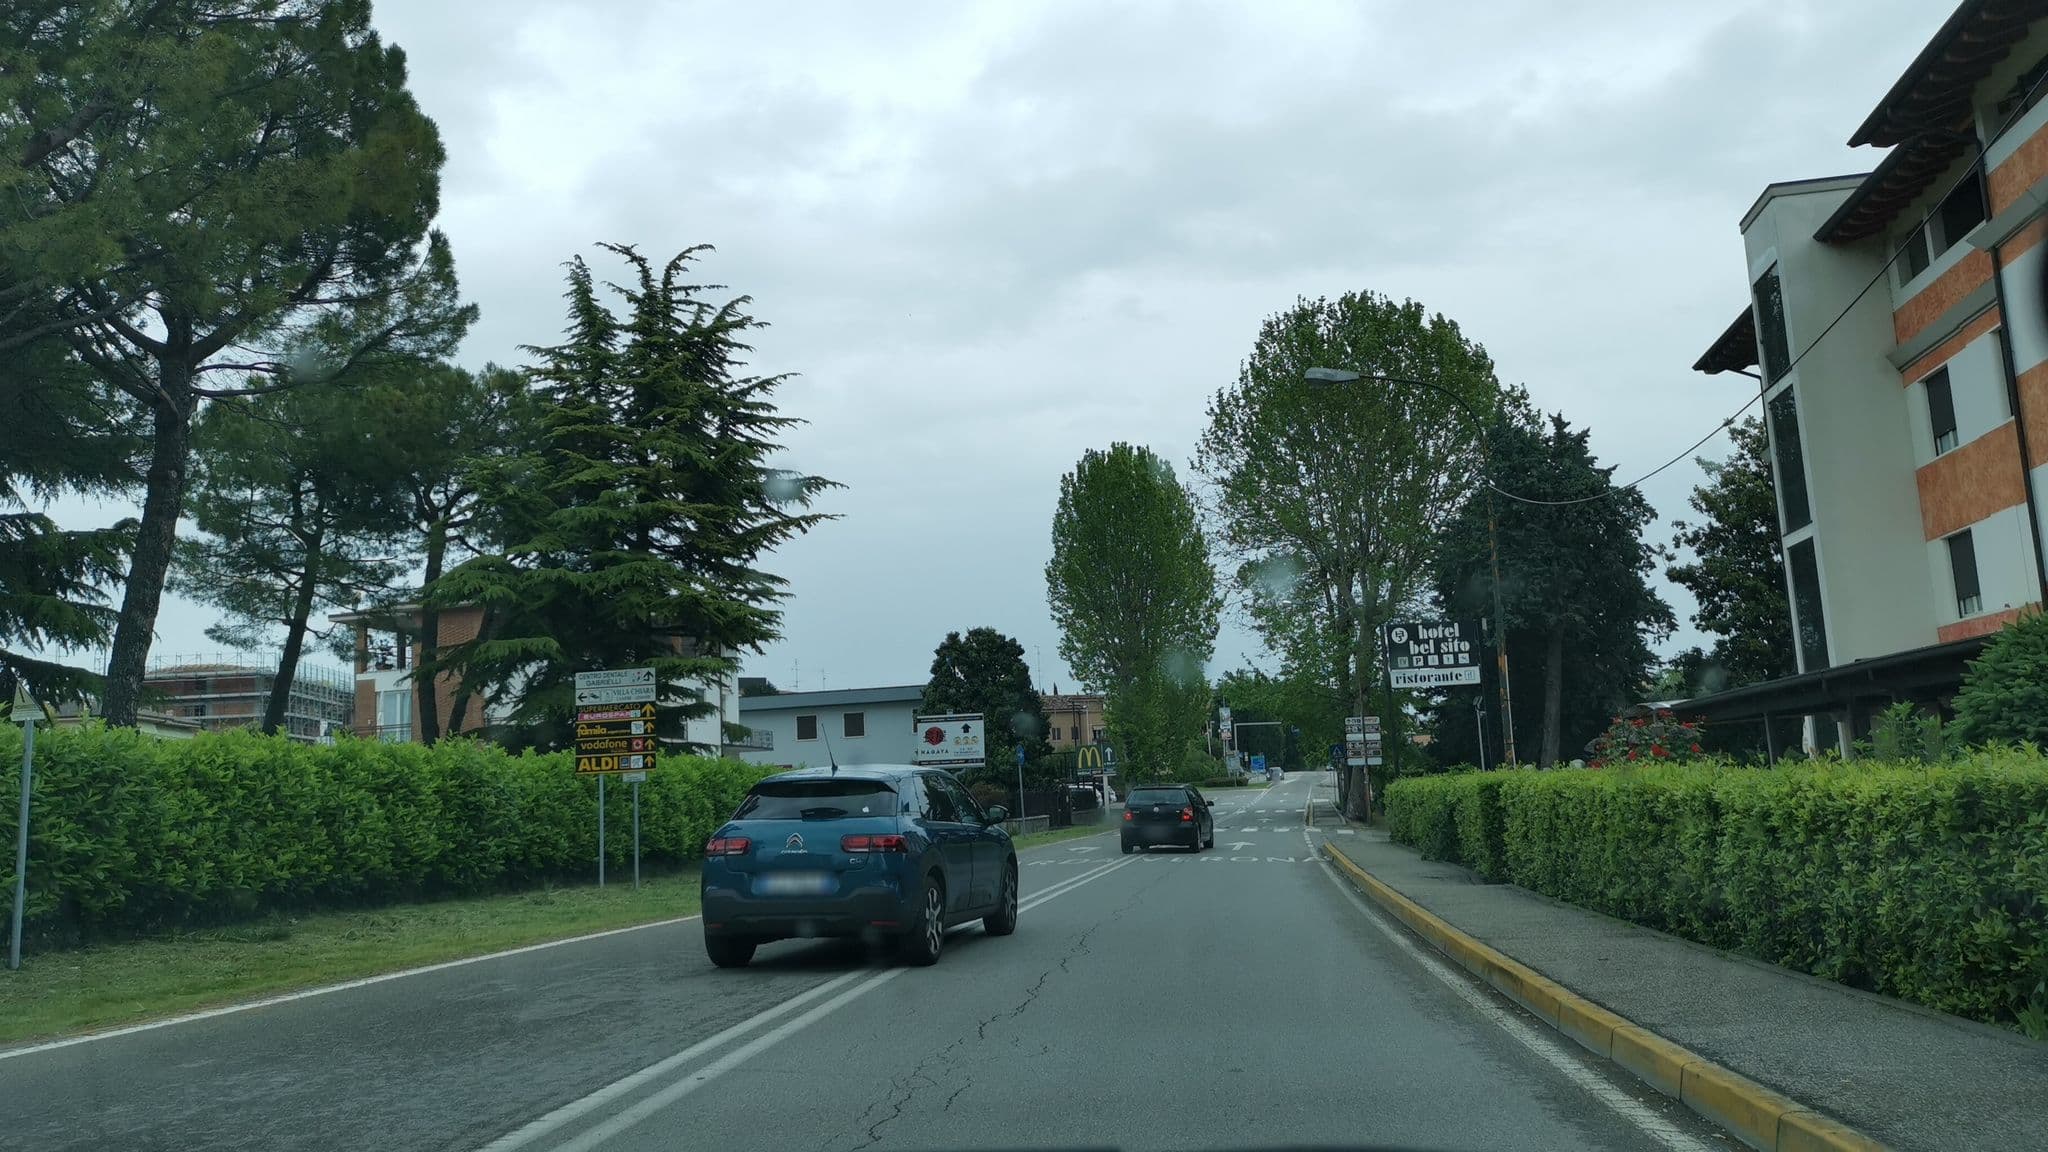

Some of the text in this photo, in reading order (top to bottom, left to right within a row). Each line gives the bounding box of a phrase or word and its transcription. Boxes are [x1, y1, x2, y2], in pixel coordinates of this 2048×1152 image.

[1418, 622, 1460, 639] hotel
[1409, 638, 1470, 655] bel sito
[579, 671, 628, 681] CENTRO DENTALE
[1395, 671, 1463, 685] ristorante
[585, 679, 622, 687] GABRIELLI
[612, 688, 630, 696] VILLA
[579, 703, 641, 713] SUPERMERCATO
[582, 710, 632, 720] EUROSPAR
[577, 724, 607, 737] famila
[581, 740, 628, 750] vodafone
[578, 756, 619, 771] ALDI
